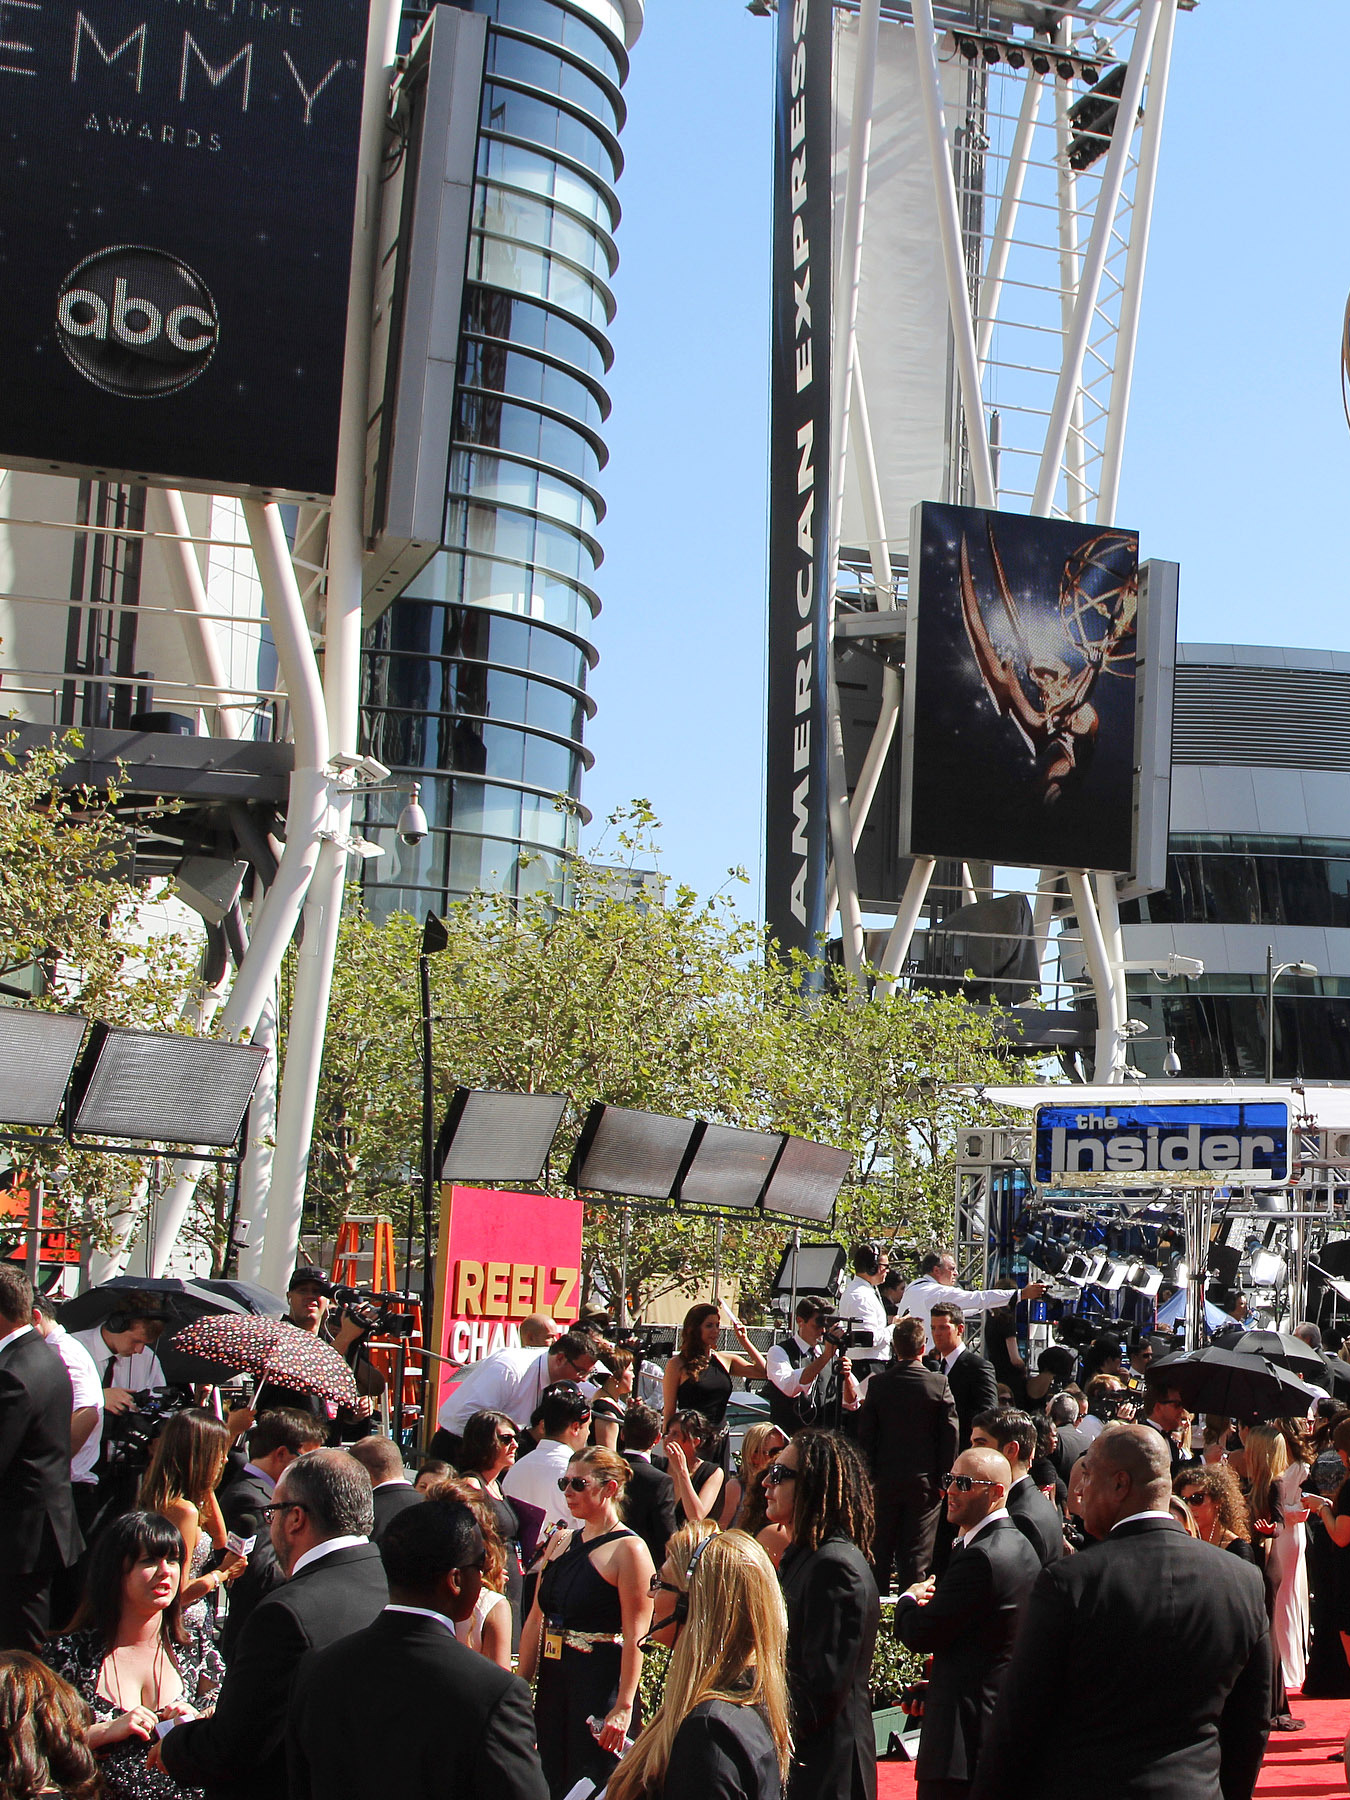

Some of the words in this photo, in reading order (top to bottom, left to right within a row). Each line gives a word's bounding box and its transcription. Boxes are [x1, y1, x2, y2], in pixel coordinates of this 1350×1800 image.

[175, 0, 303, 26] ETIME
[85, 112, 223, 152] AWARDS
[790, 0, 814, 393] EXPRESS
[57, 277, 216, 352] abc
[790, 419, 816, 928] AMERICAN
[1075, 1112, 1119, 1130] the
[1051, 1124, 1275, 1172] Insider
[454, 1259, 578, 1320] REELZ
[451, 1321, 570, 1364] CHAN
